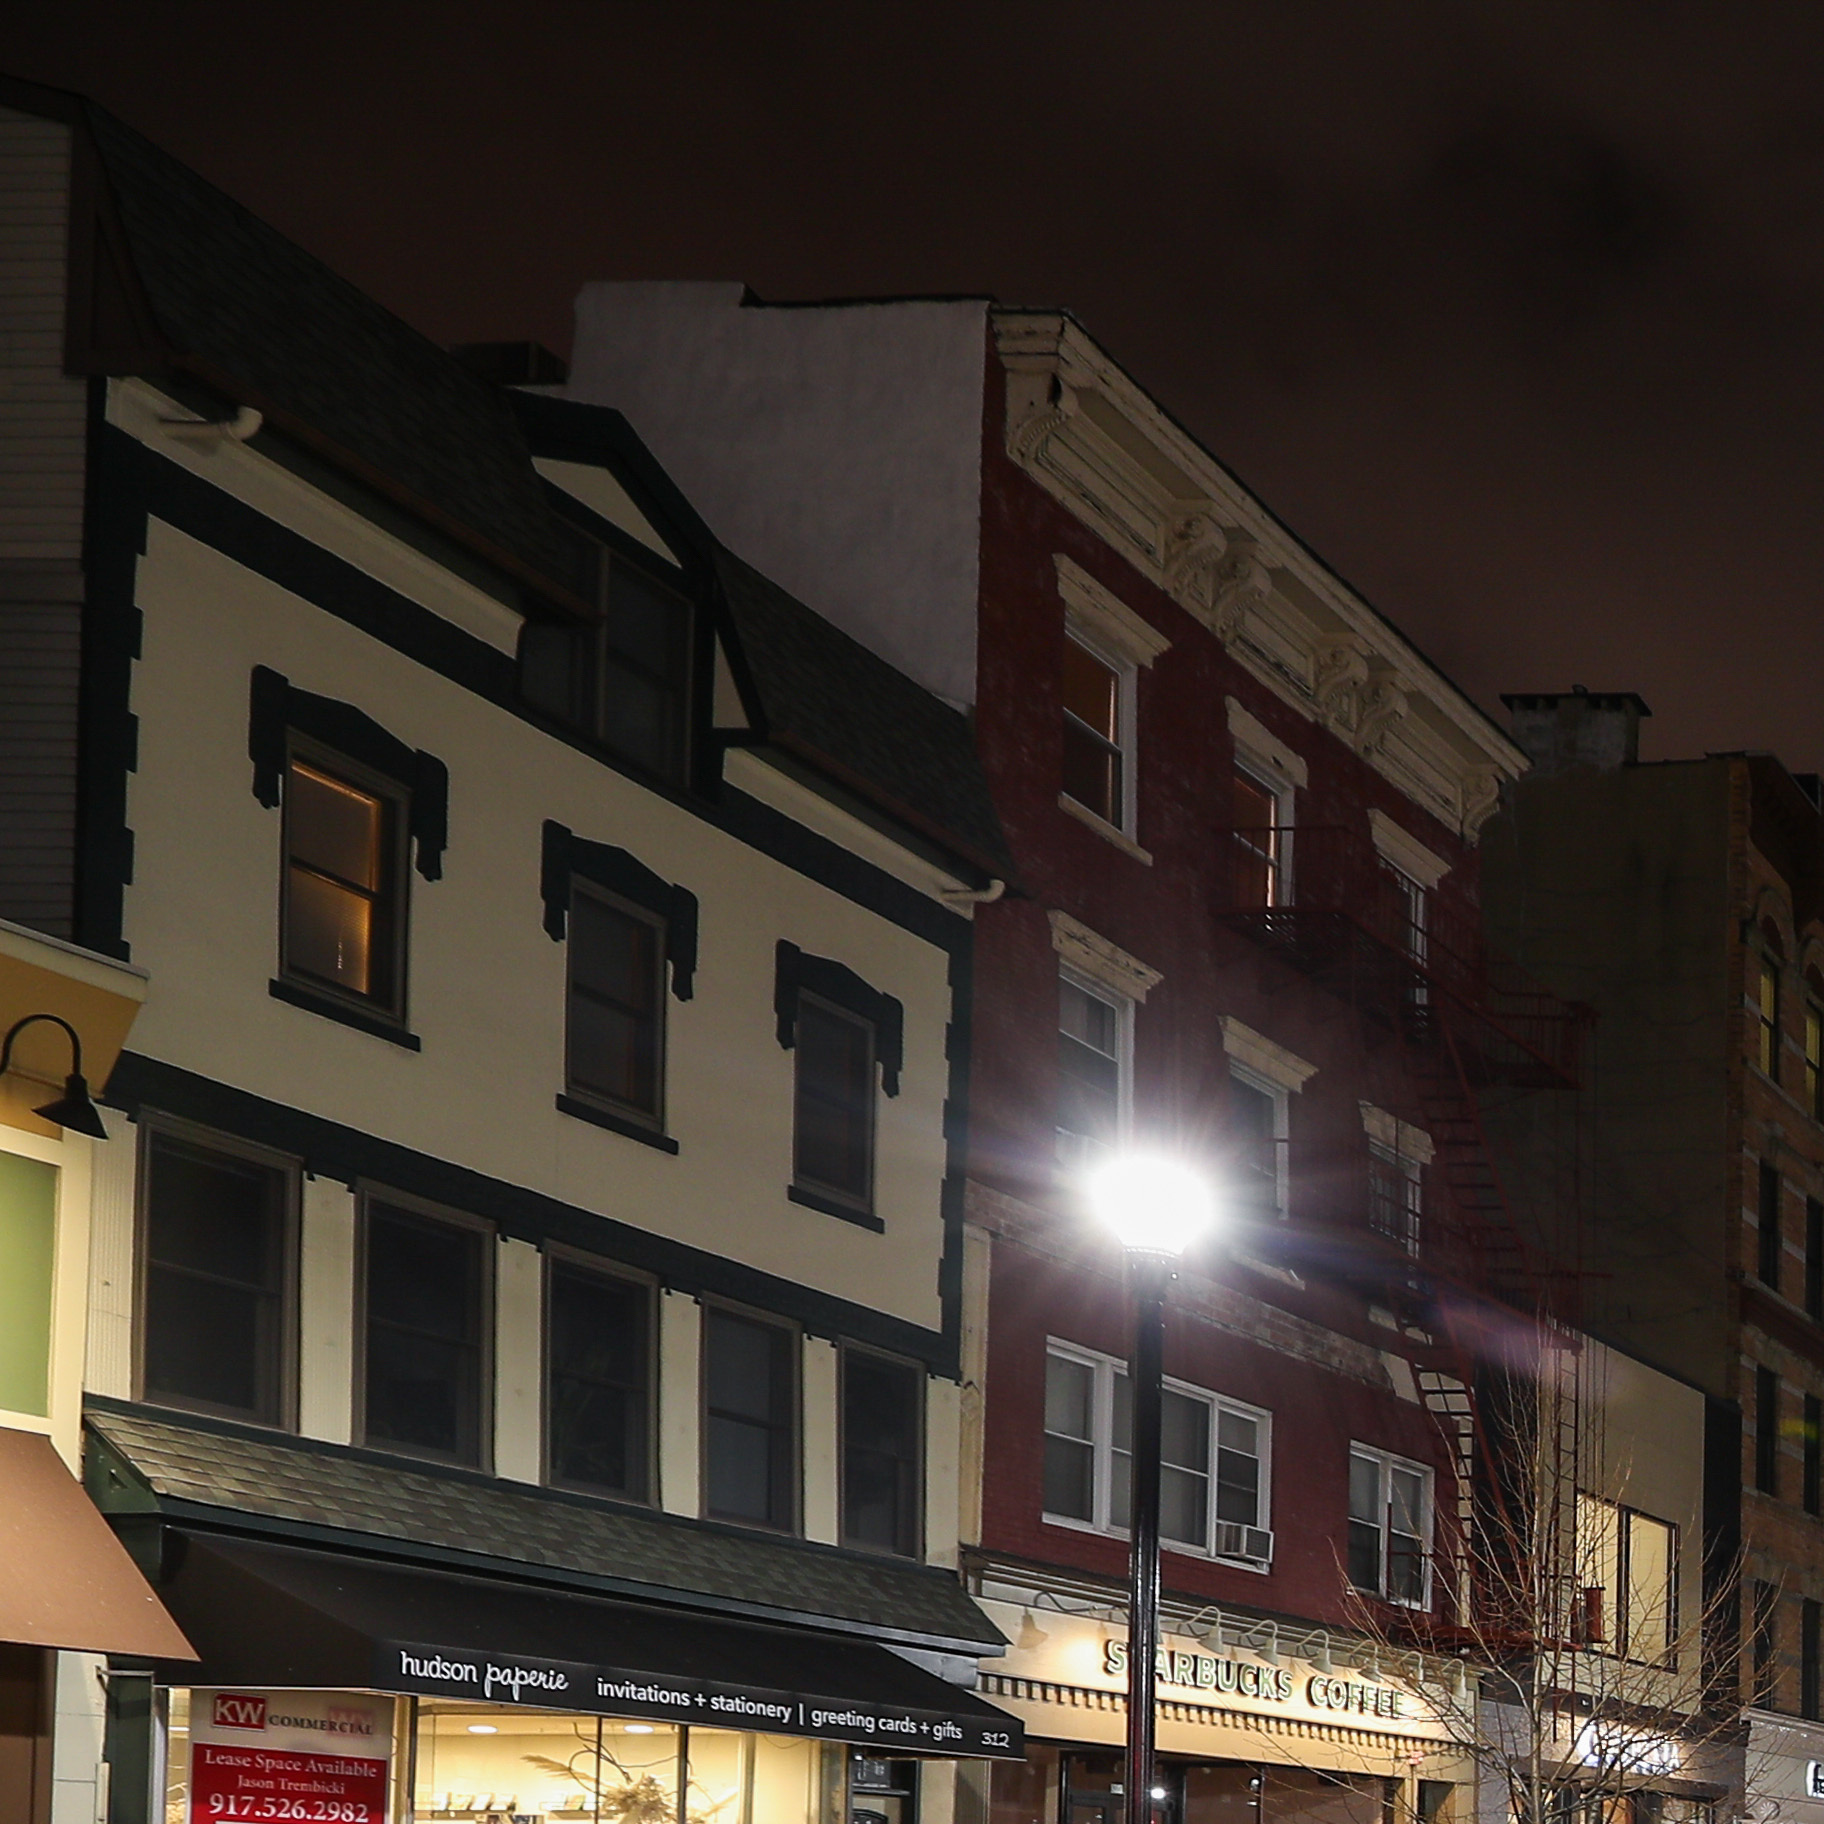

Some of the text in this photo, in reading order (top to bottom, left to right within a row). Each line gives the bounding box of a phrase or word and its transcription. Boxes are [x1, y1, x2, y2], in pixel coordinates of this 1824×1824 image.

[1104, 1639, 1405, 1718] SARBUCKS COFFEE
[400, 1651, 478, 1683] hudson
[483, 1662, 569, 1701] paperie
[597, 1677, 691, 1706] invitations
[711, 1694, 792, 1723] stationery
[811, 1709, 875, 1733] greeting
[878, 1715, 917, 1734] cards
[933, 1720, 963, 1741] gifts
[215, 1698, 264, 1725] KW
[268, 1714, 374, 1736] COMMERCIAL
[981, 1732, 1009, 1748] 312
[205, 1749, 377, 1778] Lease Space Available
[237, 1774, 345, 1795] Jason Trembicki
[209, 1792, 369, 1824] 917.526.2982
